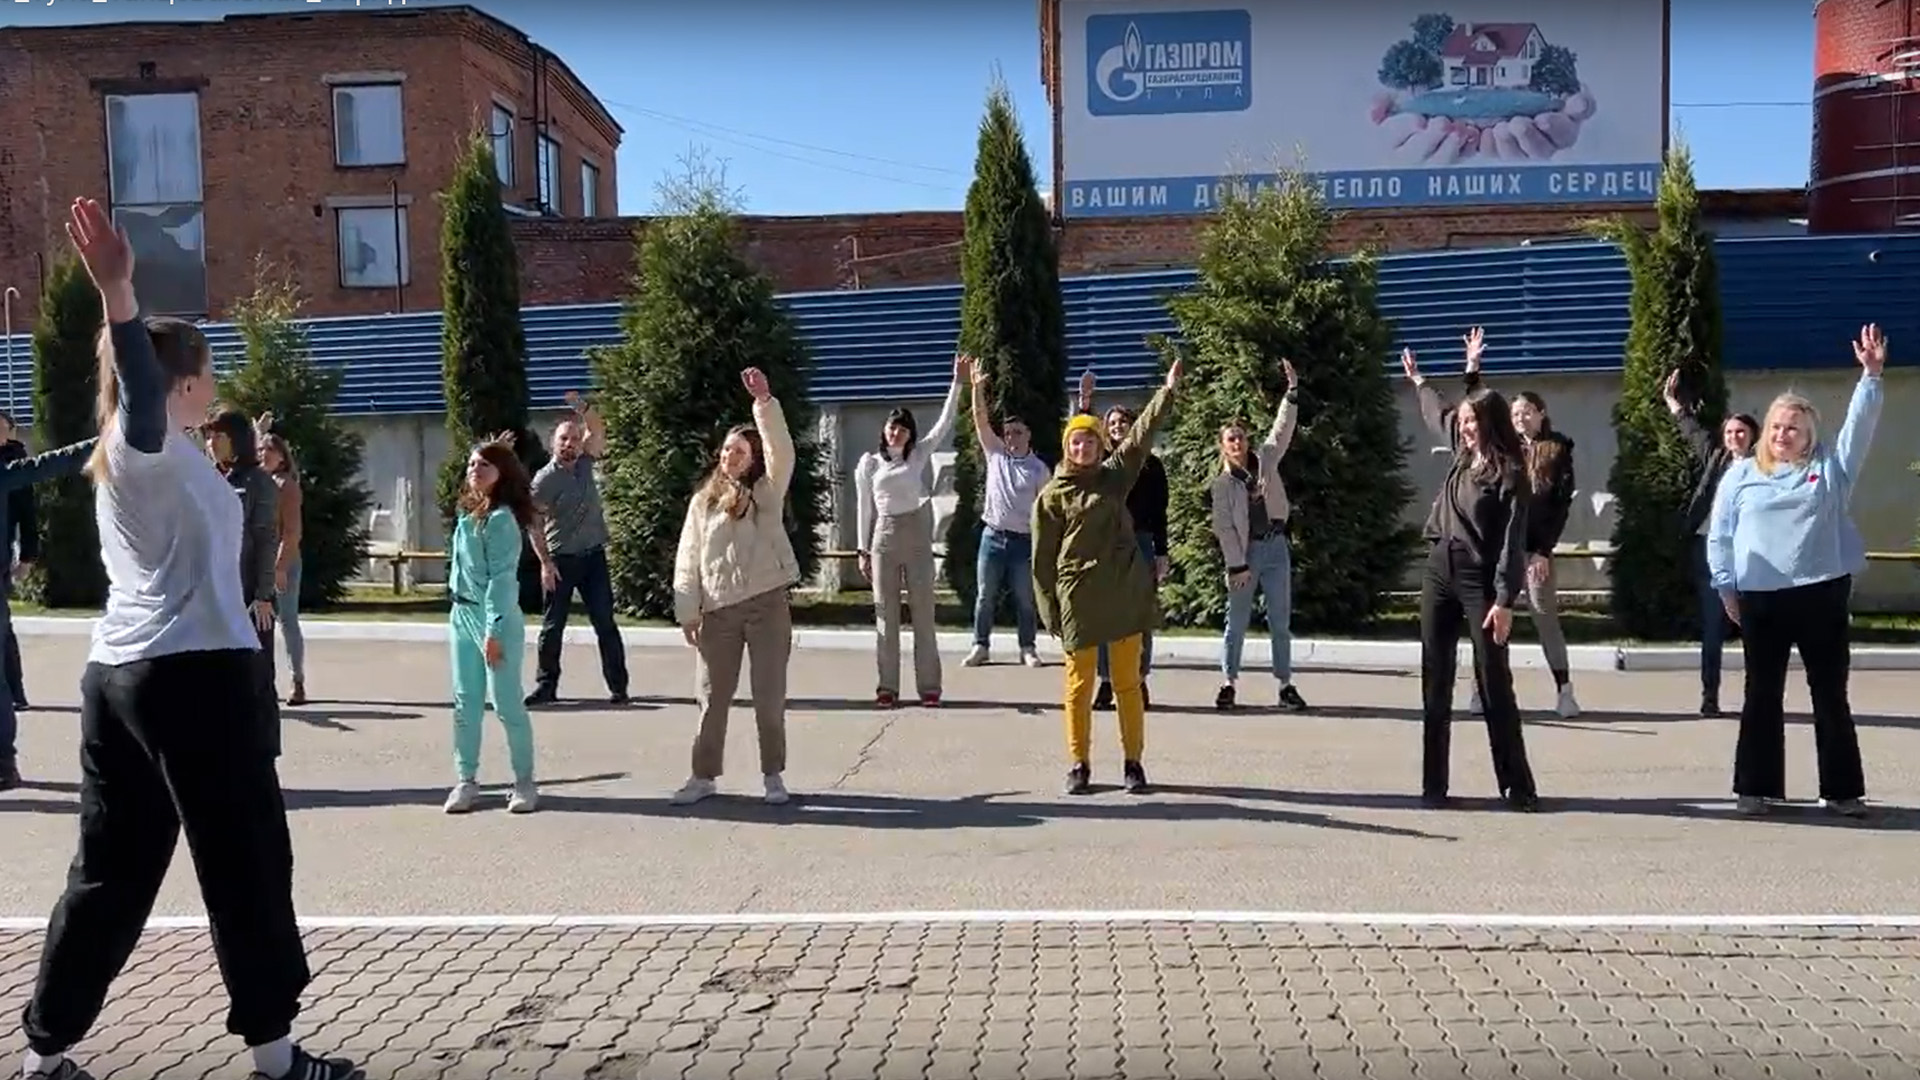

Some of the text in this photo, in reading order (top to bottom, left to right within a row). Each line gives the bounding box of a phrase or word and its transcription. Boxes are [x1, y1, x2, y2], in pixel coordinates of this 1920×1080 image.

[1145, 41, 1242, 69] ГАЗПРОМ
[1145, 86, 1242, 99] ТУЛА
[1072, 185, 1168, 208] ВАШИМ
[1317, 177, 1401, 200] ТЕПЛО
[1428, 172, 1523, 197] НАШИХ
[1549, 170, 1654, 195] СЕРДЕЦ
